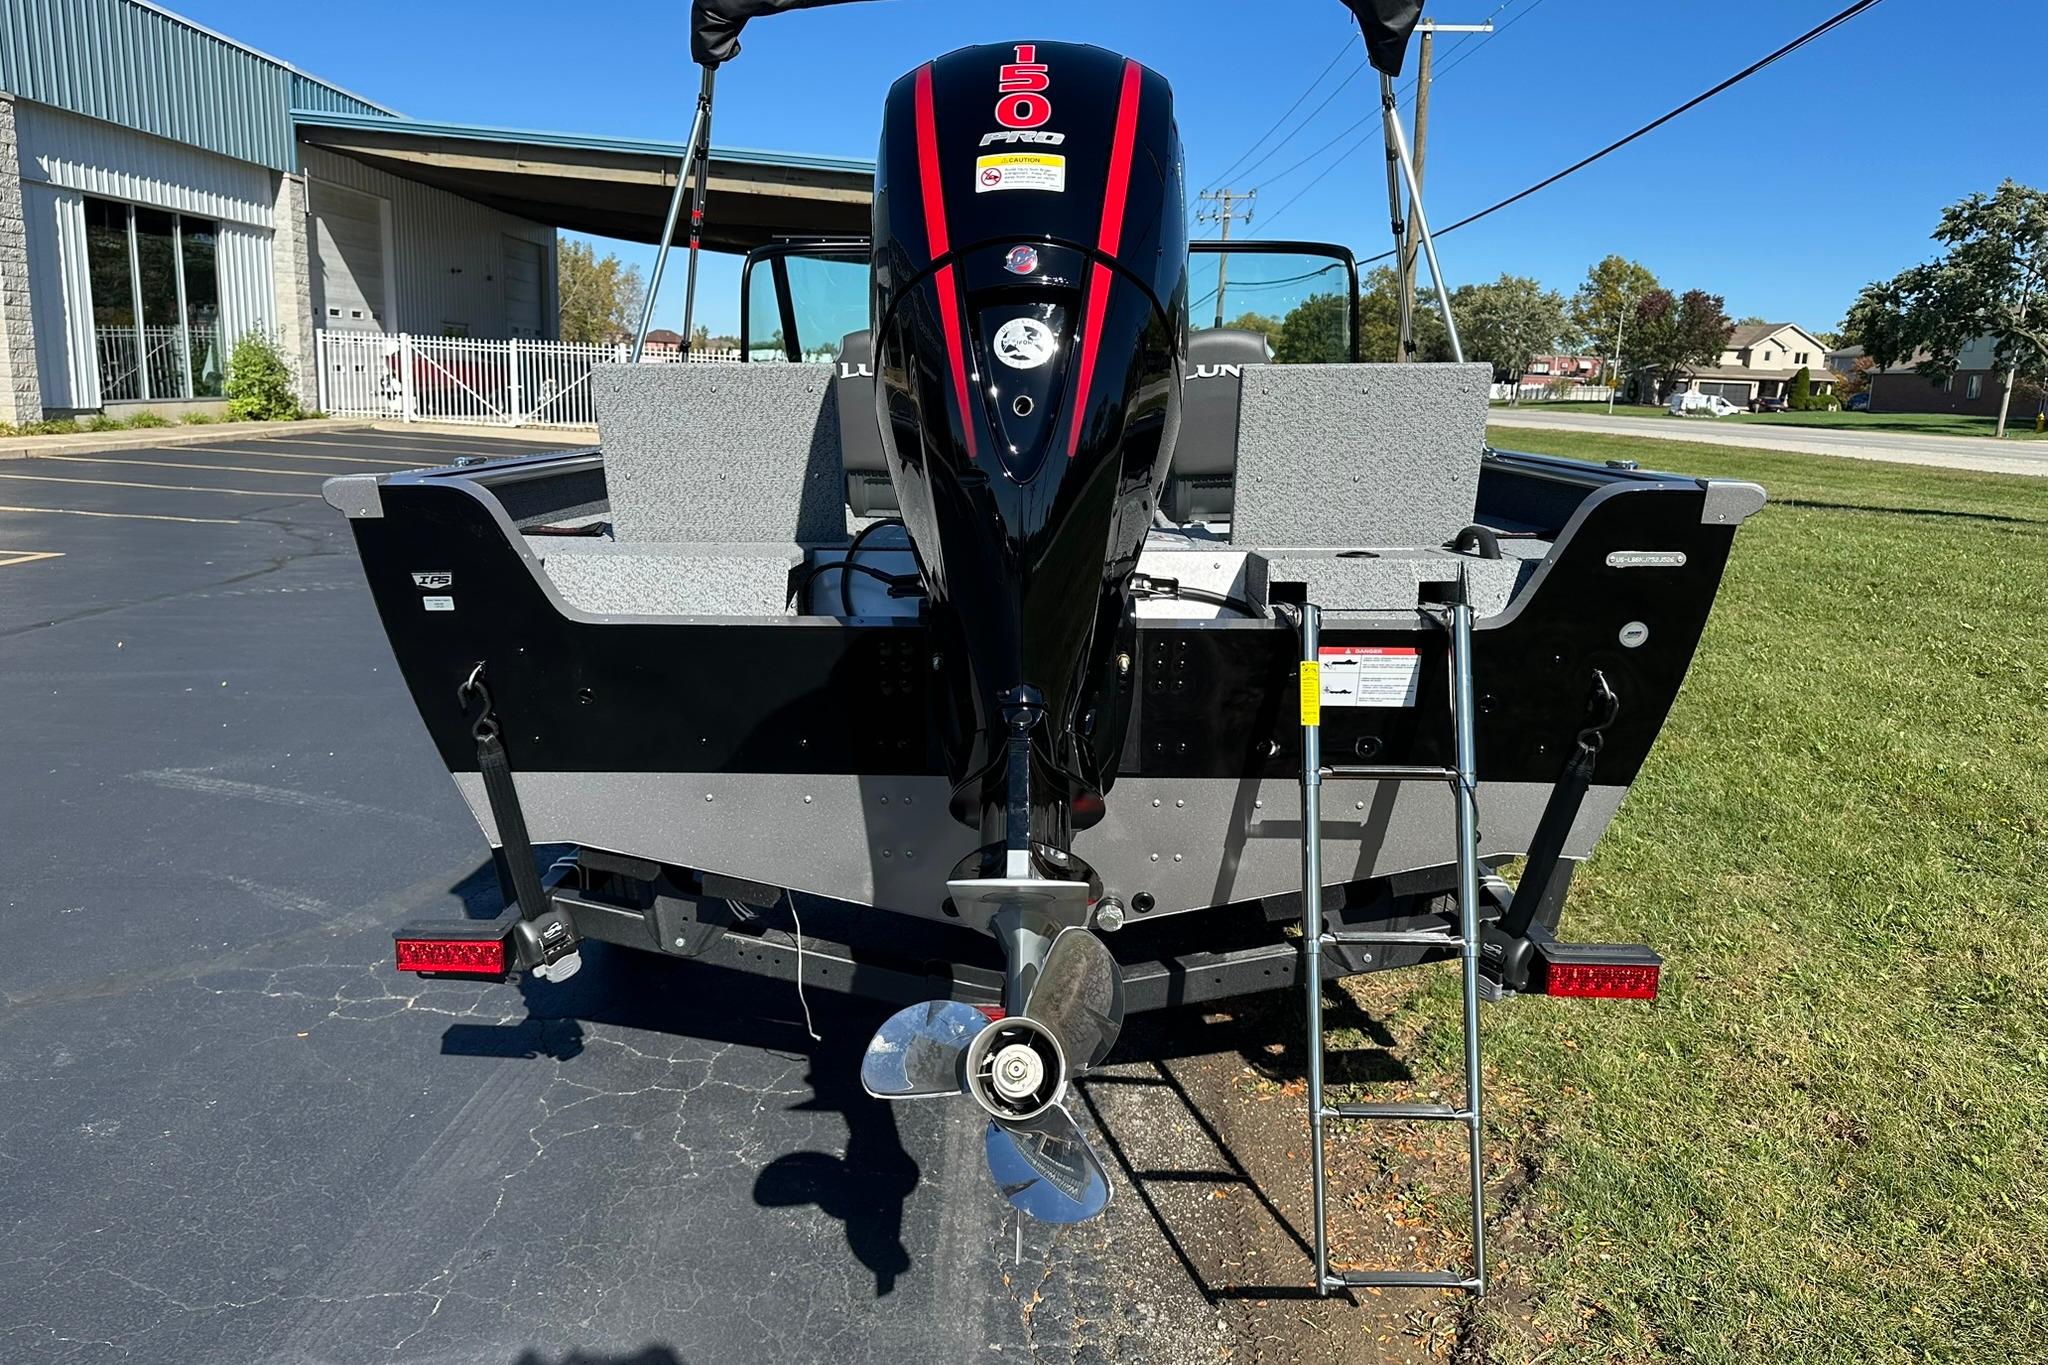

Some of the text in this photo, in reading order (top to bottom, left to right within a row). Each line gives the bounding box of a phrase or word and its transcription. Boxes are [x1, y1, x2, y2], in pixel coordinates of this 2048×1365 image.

[995, 45, 1051, 128] 150
[979, 131, 1065, 146] PRO
[840, 362, 873, 378] LU
[418, 575, 450, 584] IPS
